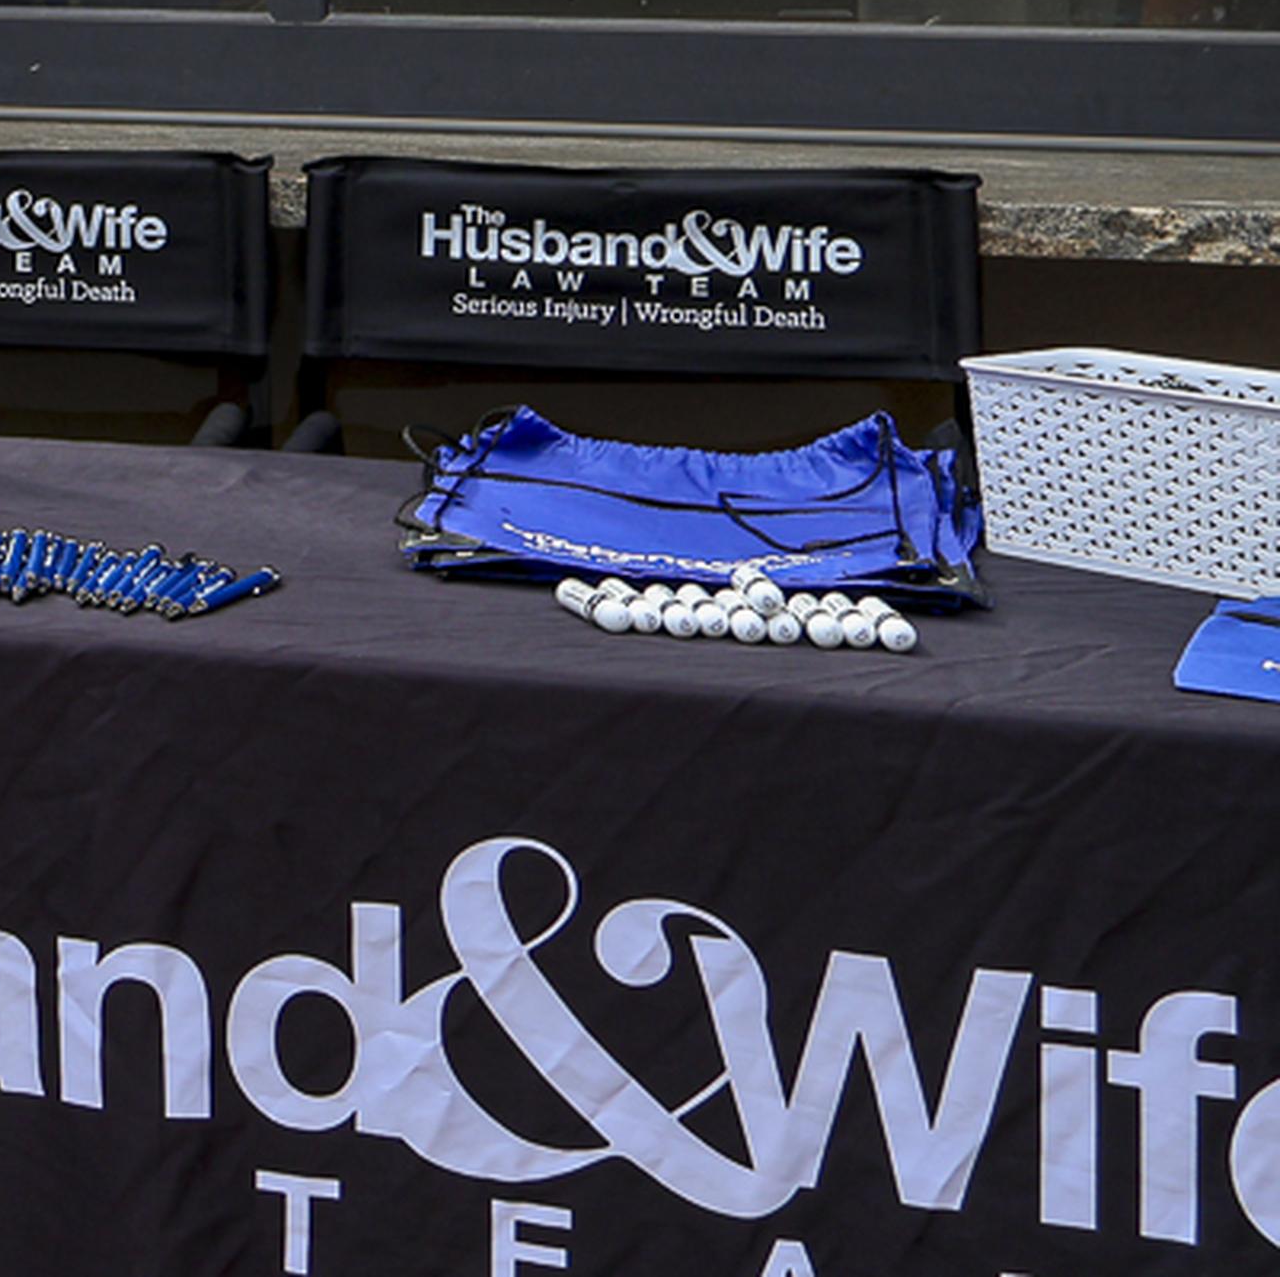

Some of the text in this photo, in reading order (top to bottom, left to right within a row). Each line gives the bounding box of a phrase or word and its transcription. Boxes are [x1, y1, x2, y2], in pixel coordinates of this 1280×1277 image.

[461, 204, 507, 225] The
[71, 280, 137, 302] Death
[452, 292, 538, 317] Serious
[543, 297, 616, 326] Injury
[634, 302, 748, 330] Wrongful
[753, 305, 827, 330] Death
